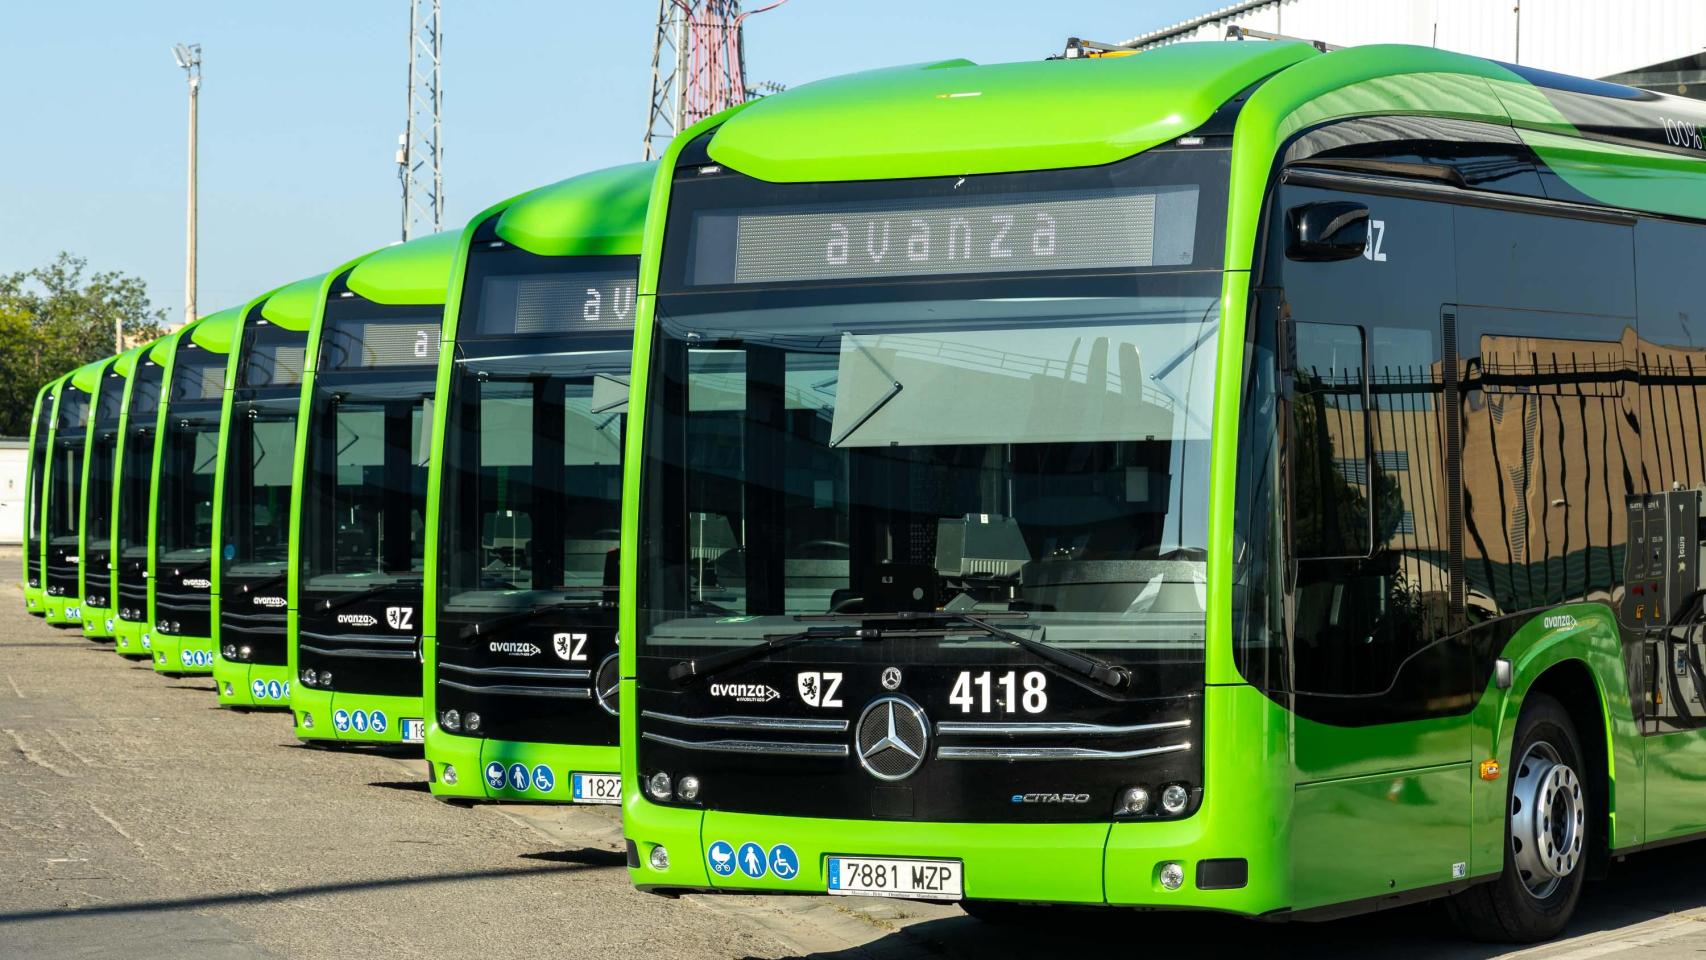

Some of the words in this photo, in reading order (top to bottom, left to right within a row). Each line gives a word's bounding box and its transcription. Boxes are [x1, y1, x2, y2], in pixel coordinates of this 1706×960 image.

[1659, 116, 1703, 150] 100%
[826, 212, 1057, 266] avanza
[1372, 219, 1387, 262] Z
[253, 597, 280, 605] avanza
[337, 614, 369, 623] avanza
[400, 607, 413, 630] Z
[1543, 614, 1571, 629] avanza
[489, 641, 530, 653] avanza
[570, 633, 587, 661] Z
[710, 683, 766, 697] avanza
[821, 672, 843, 708] Z
[949, 670, 1048, 714] 4118
[847, 863, 898, 889] 7881
[911, 865, 952, 891] MZP
